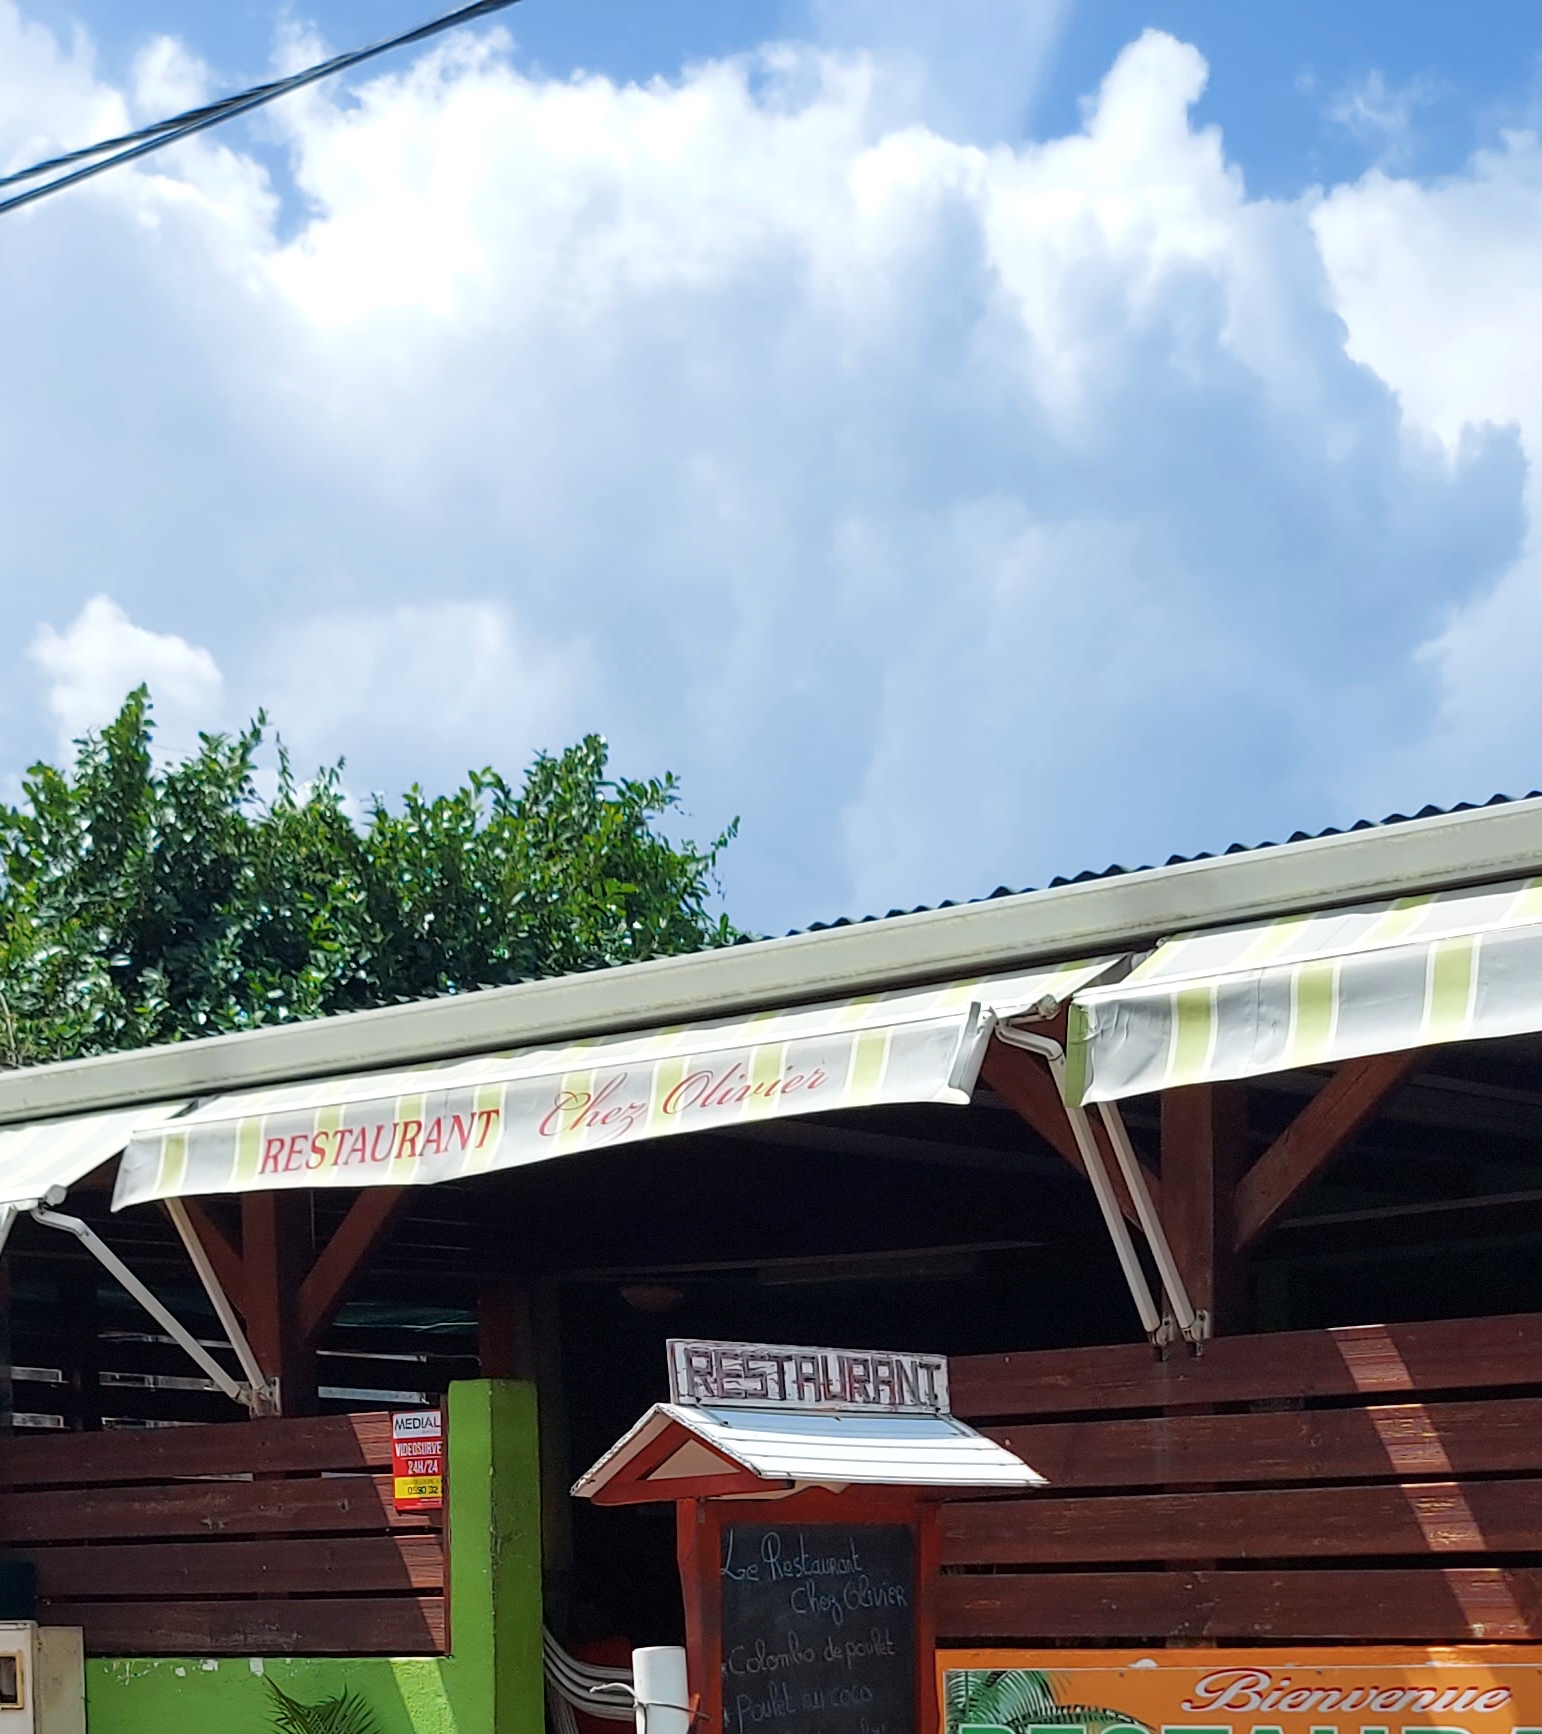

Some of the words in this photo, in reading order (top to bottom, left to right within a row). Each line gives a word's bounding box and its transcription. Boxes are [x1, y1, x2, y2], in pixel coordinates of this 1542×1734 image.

[259, 1108, 500, 1175] RESTAURANT
[539, 1072, 647, 1146] Chez
[662, 1062, 829, 1114] Olivier
[683, 1347, 942, 1404] RESTAURANT
[408, 1460, 438, 1474] 24H/24
[721, 1529, 759, 1580] Le
[761, 1532, 862, 1580] Restaurant
[791, 1579, 843, 1625] Chez
[1181, 1667, 1512, 1713] Bienvenue
